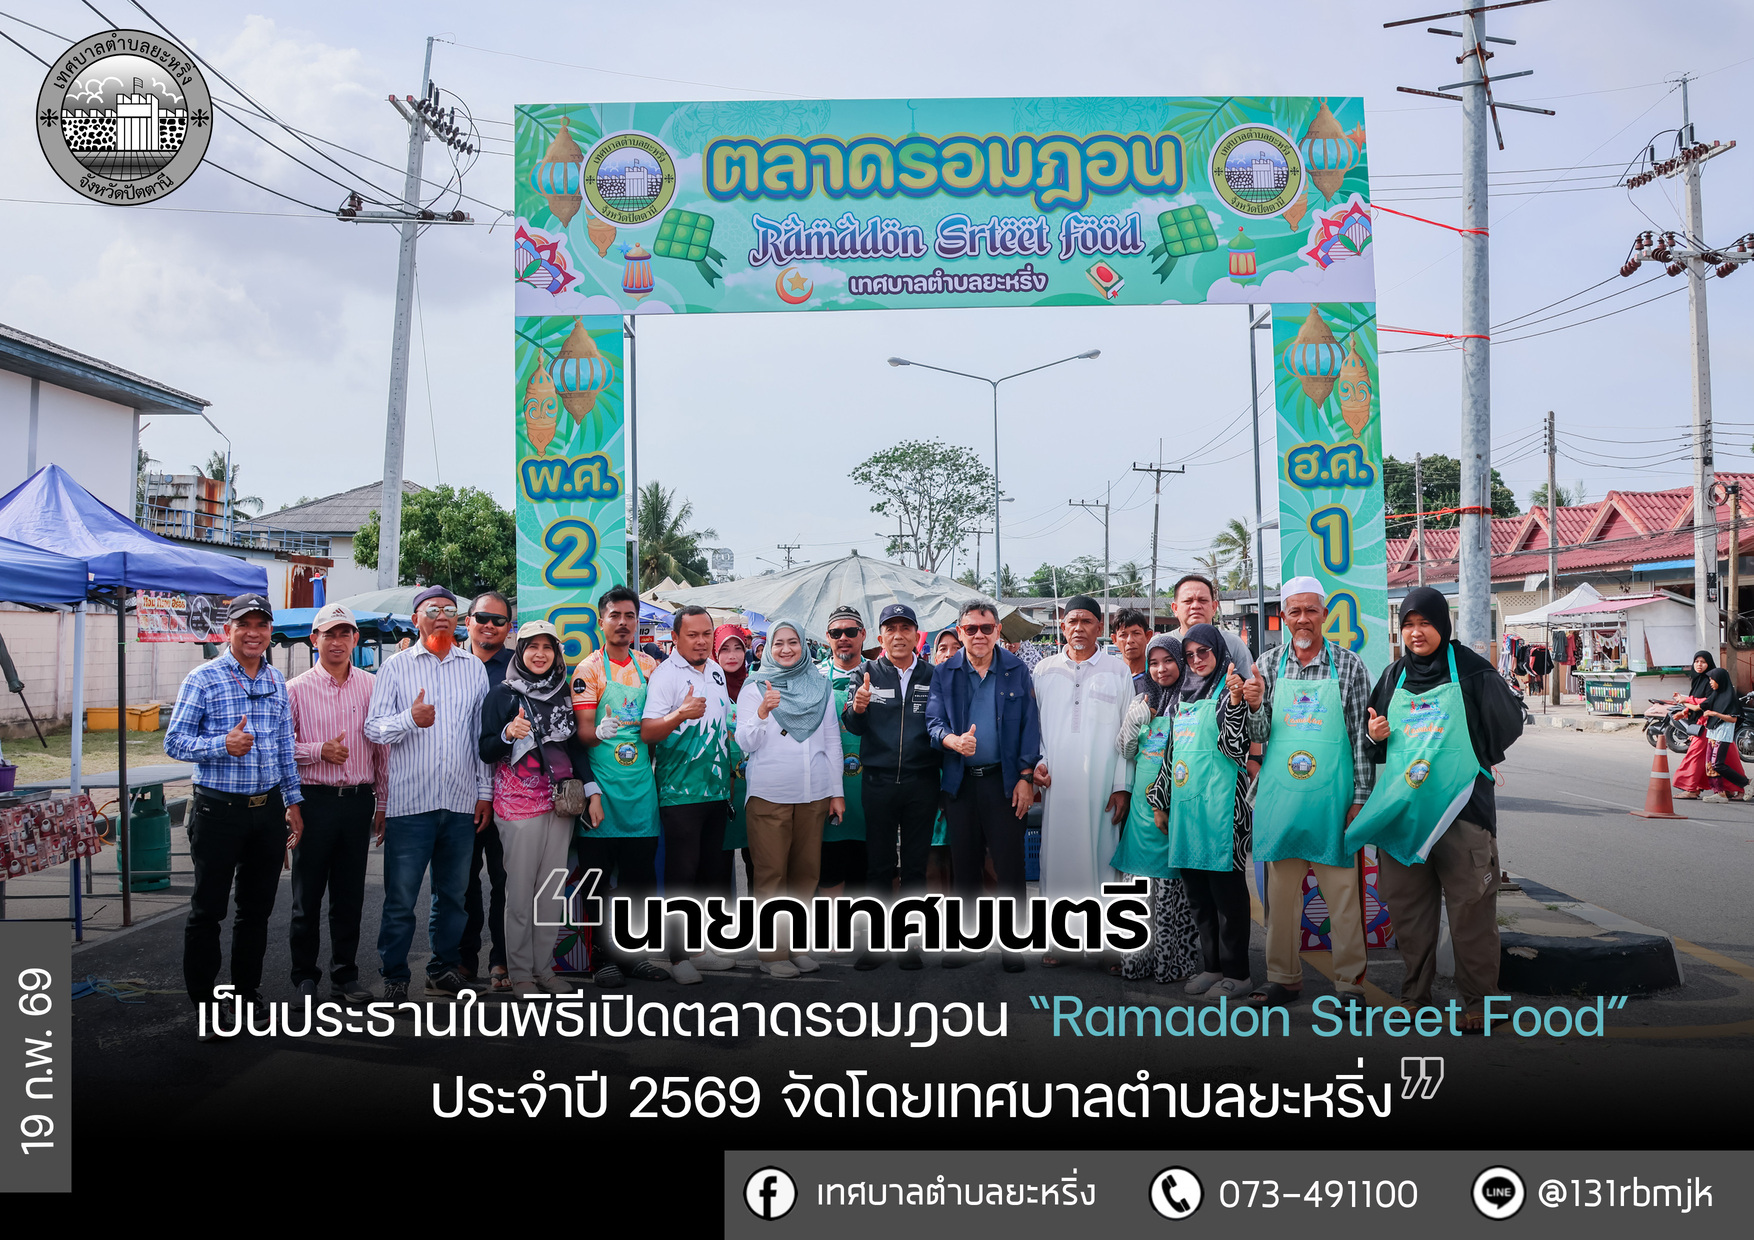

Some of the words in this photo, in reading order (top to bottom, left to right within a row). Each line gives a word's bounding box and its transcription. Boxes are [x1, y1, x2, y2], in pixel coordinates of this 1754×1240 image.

[709, 138, 1181, 209] ตลาดรอมฎอน
[849, 264, 1047, 295] เทศบาลตำบลยะหริ่ง
[523, 457, 616, 497] พ.ศ.
[1290, 445, 1372, 484] ฮ.ศ.
